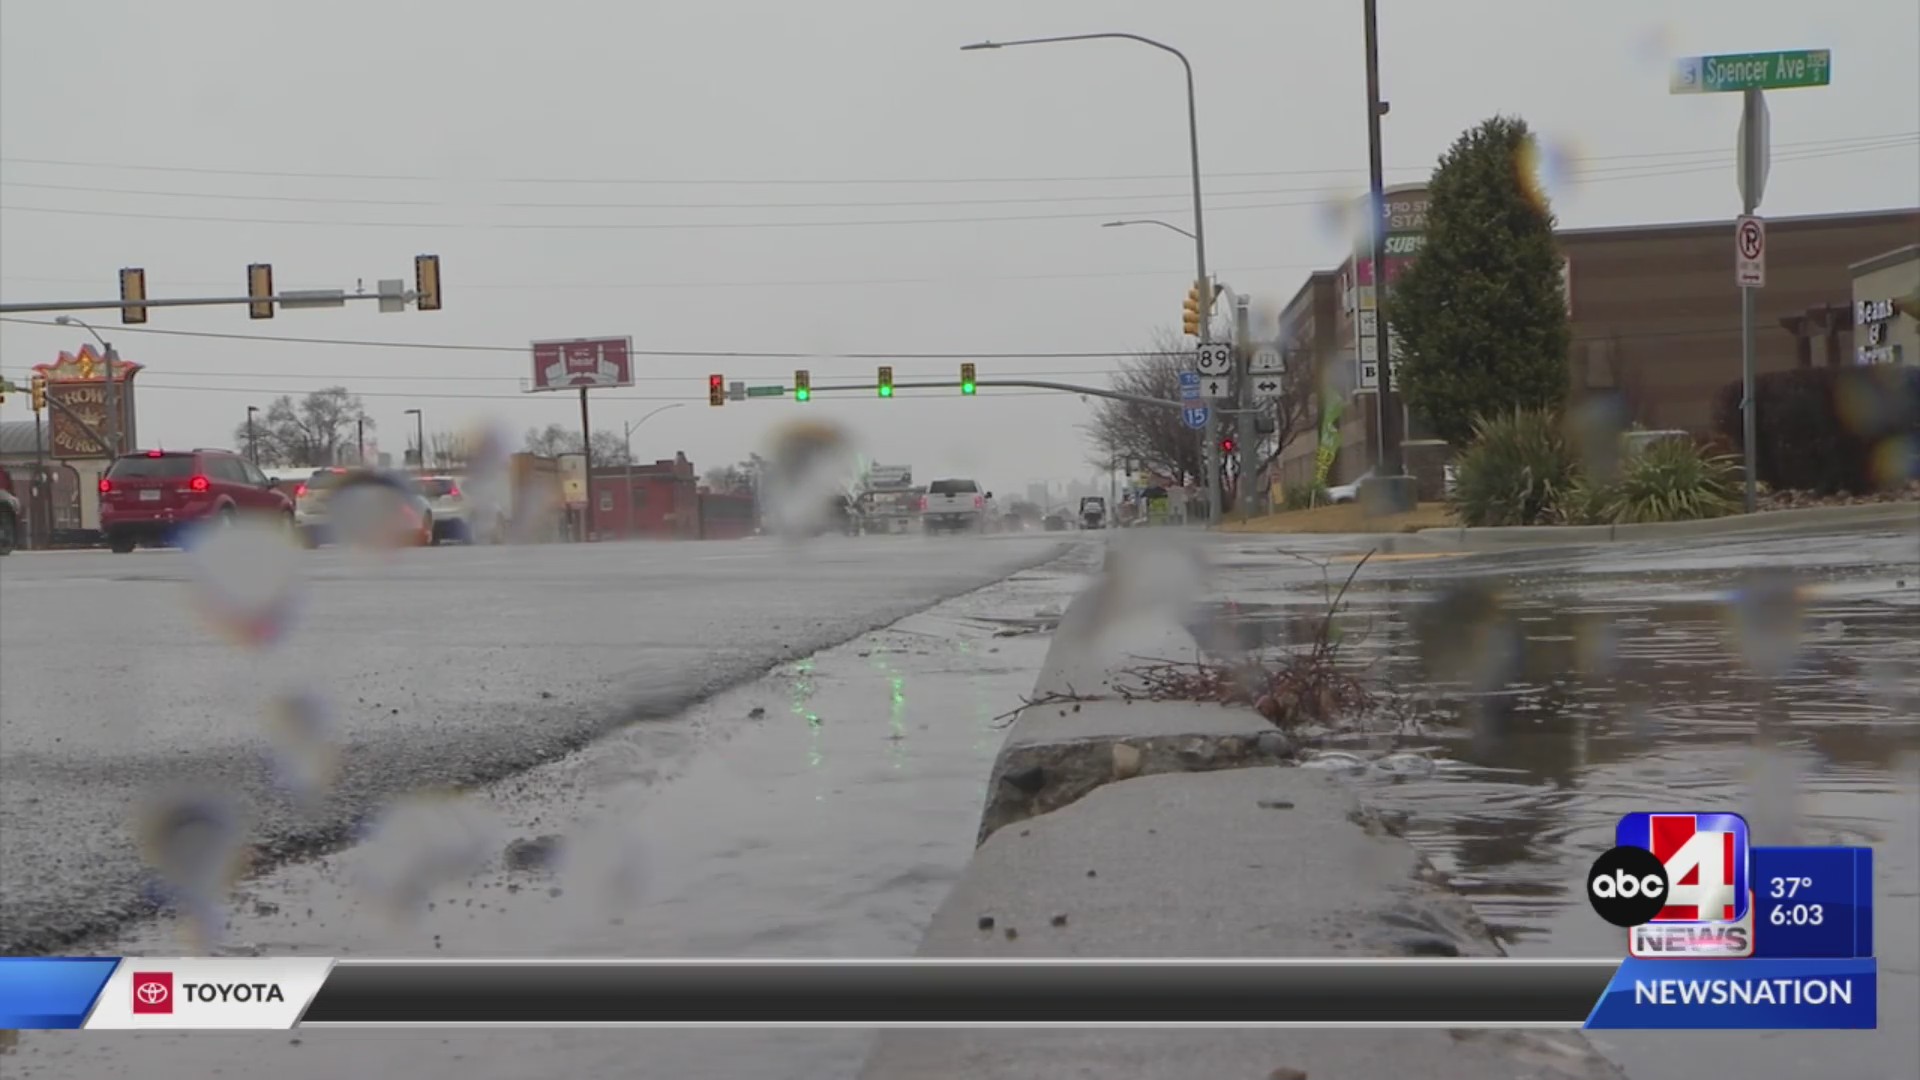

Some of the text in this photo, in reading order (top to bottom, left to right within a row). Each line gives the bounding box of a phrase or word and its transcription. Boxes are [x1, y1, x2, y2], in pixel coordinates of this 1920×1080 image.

[1706, 54, 1805, 88] Spencer Ave
[1857, 298, 1894, 324] Beans
[1201, 350, 1227, 368] 89
[1187, 408, 1206, 425] 15
